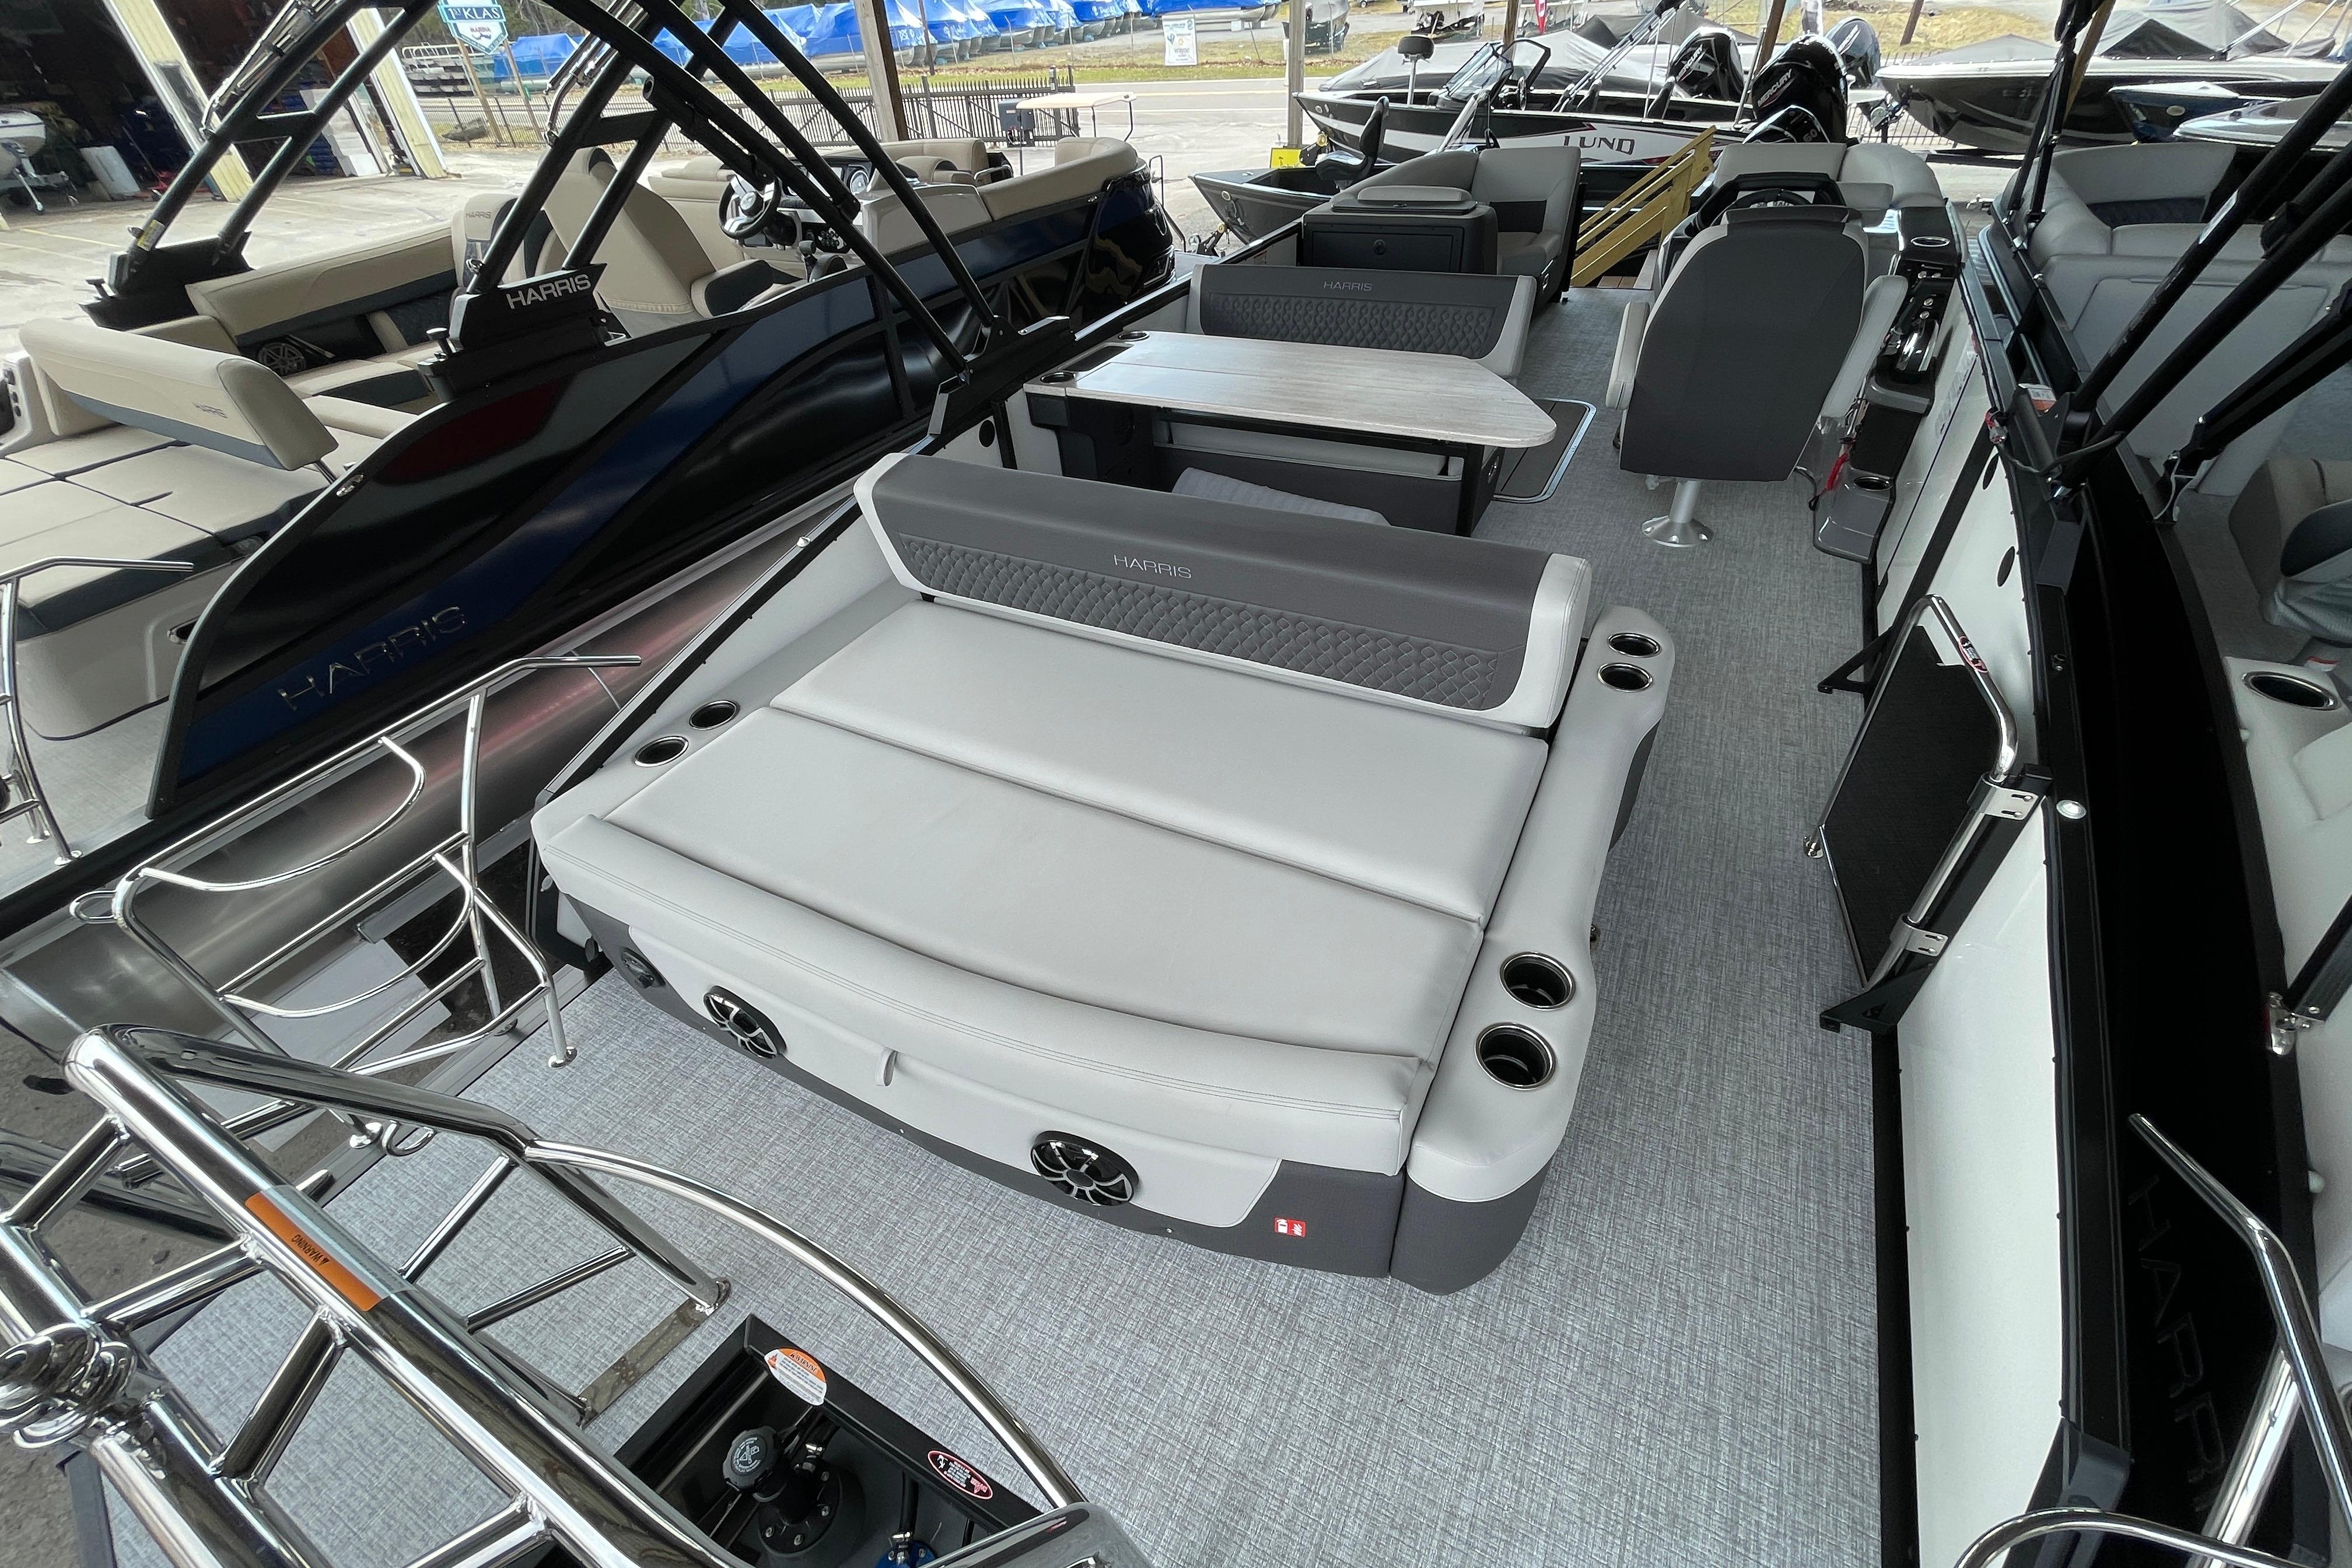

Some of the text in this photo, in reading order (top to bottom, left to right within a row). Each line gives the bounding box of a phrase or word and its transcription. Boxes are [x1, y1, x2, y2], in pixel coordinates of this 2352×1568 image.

[462, 8, 501, 19] KLAS
[1758, 68, 1792, 107] MERCURY
[506, 274, 591, 309] HARRIS
[1324, 281, 1372, 291] HARRIS
[1114, 555, 1192, 579] HARRIS
[277, 607, 465, 711] HARRIS
[292, 1234, 323, 1262] WARNING
[2129, 1174, 2225, 1512] HARRI
